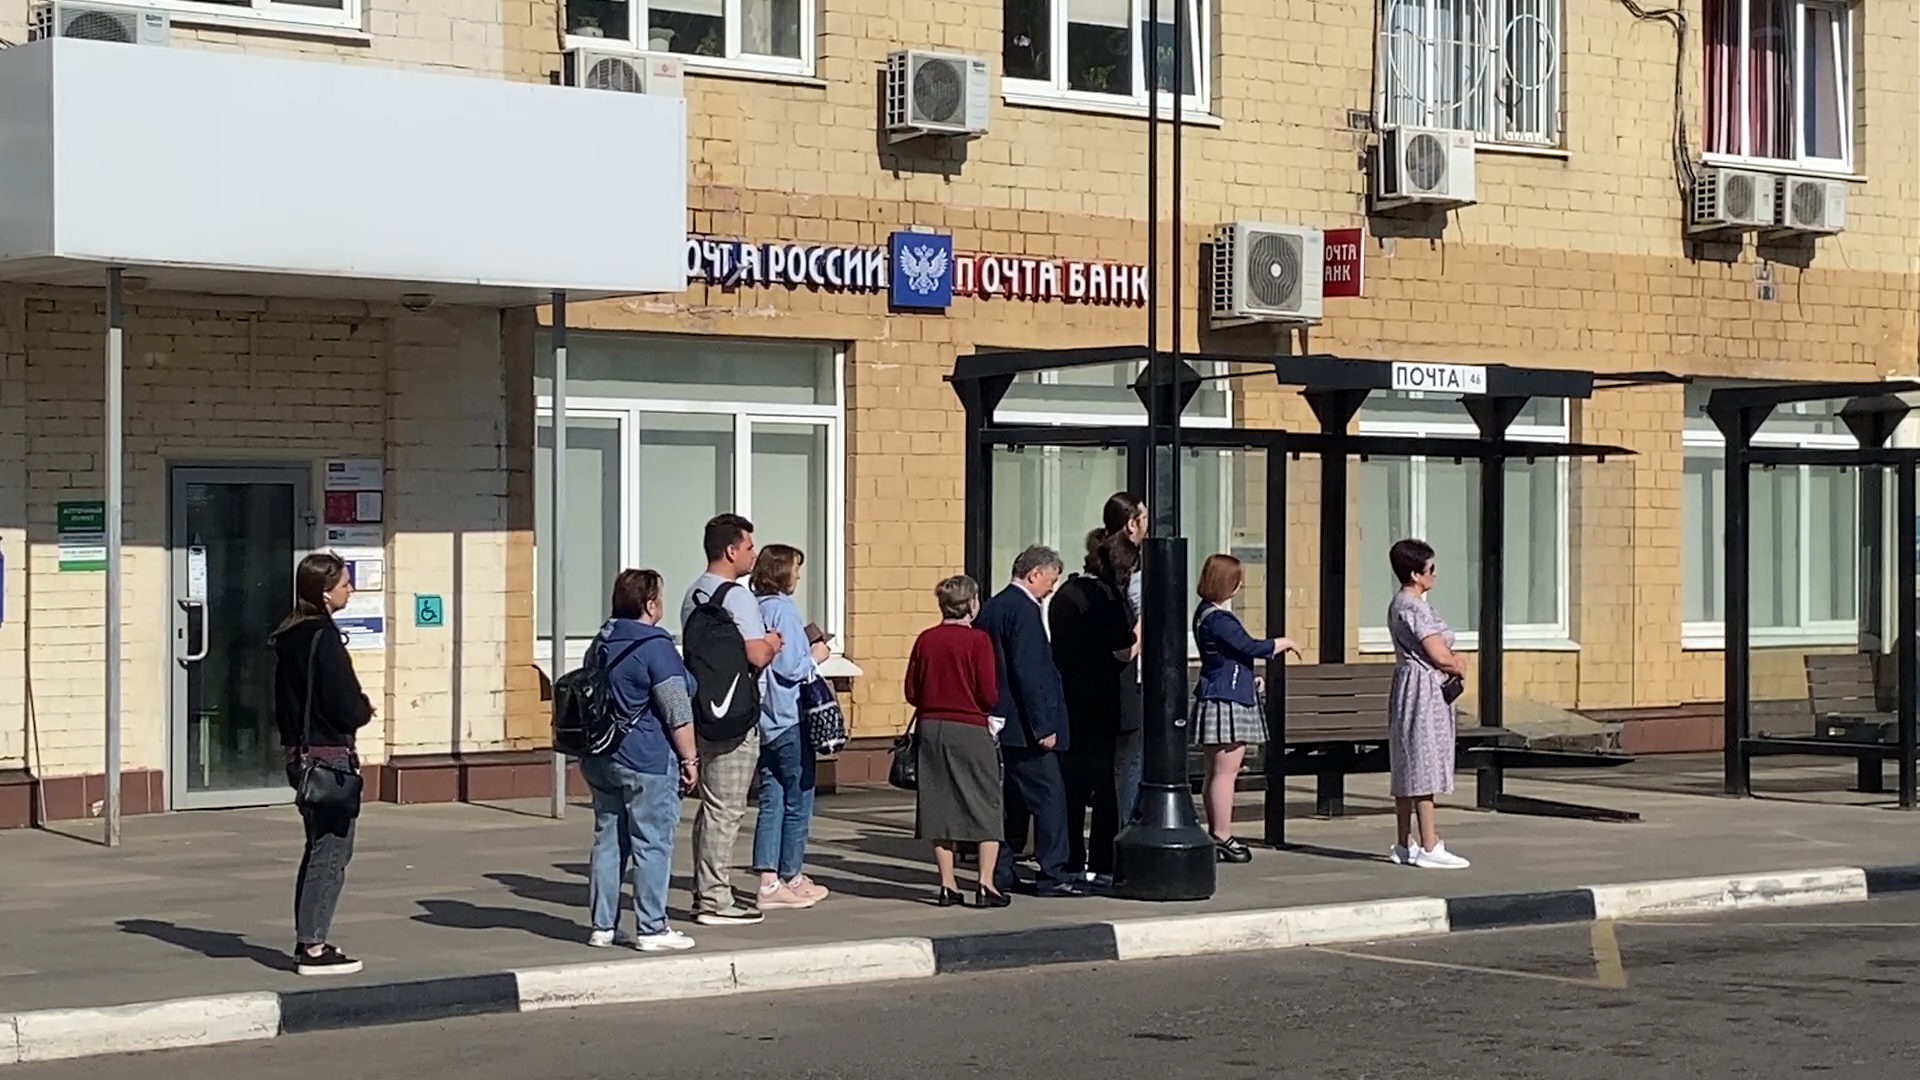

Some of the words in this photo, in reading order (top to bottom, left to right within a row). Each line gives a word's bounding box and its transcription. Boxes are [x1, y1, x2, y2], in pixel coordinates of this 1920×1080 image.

[767, 245, 884, 288] РОССИИ
[956, 257, 1058, 297] ПОЧТА
[1069, 263, 1149, 301] БАНК
[1397, 366, 1460, 388] ПОЧТА
